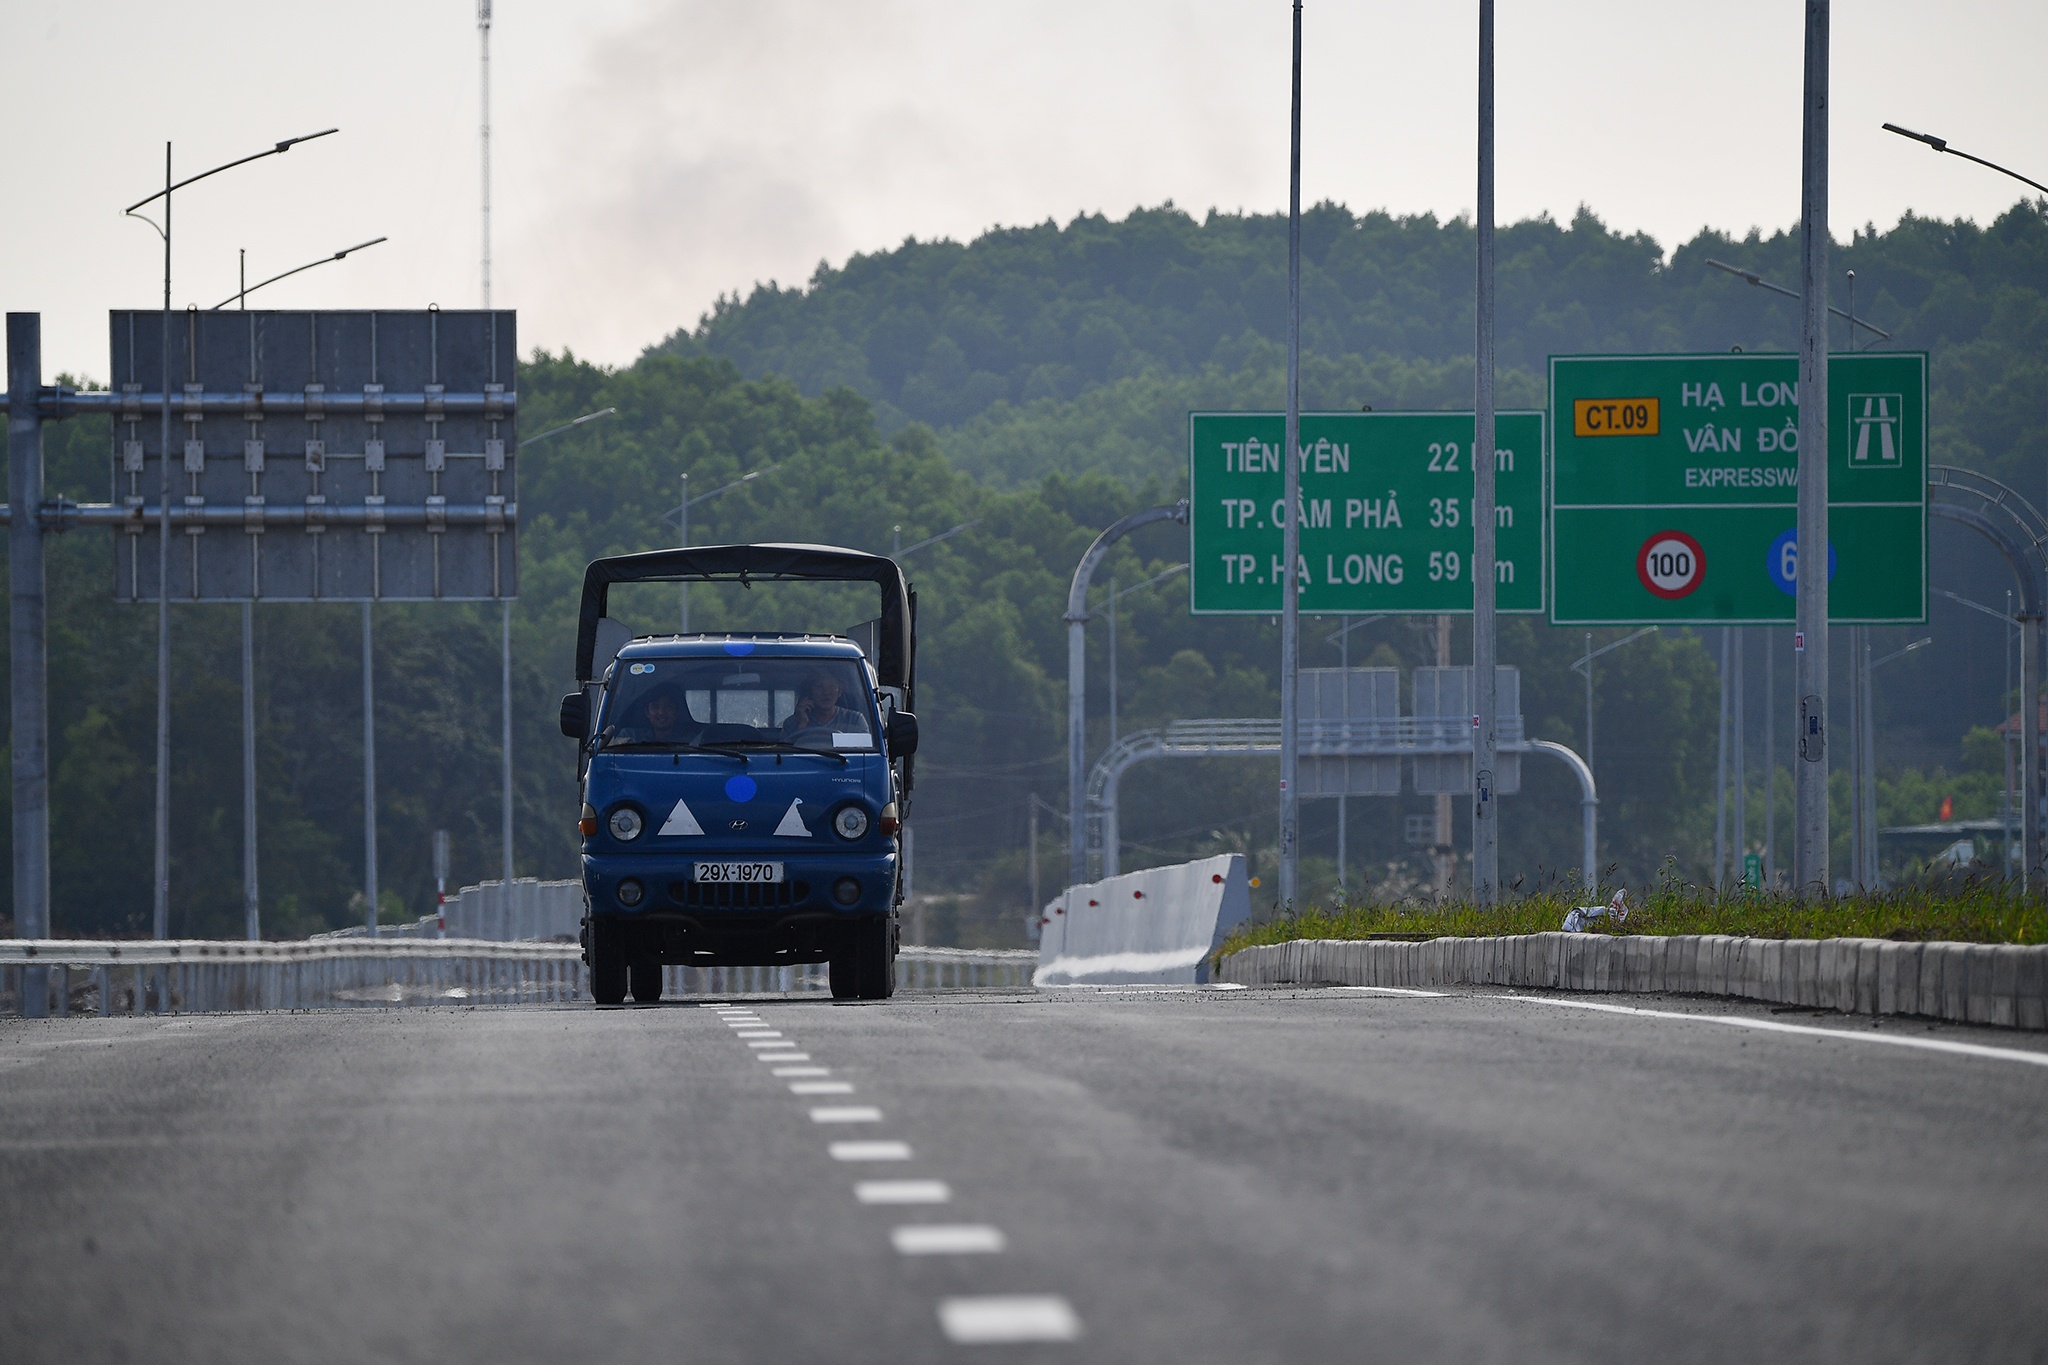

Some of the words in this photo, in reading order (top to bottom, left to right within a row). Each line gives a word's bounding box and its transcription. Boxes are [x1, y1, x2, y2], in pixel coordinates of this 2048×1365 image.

[1682, 382, 1725, 412] HẠ
[1741, 382, 1798, 407] LON
[1586, 404, 1648, 430] CT.09
[1683, 423, 1741, 453] VÂN
[1756, 416, 1798, 452] ĐỒ
[1221, 437, 1279, 472] TIÊN
[1299, 437, 1349, 473] YÊN
[1427, 442, 1459, 472] 22
[1472, 442, 1514, 472] m
[1685, 467, 1799, 488] EXPRESSW
[1345, 490, 1402, 528] PHẢ
[1429, 497, 1460, 528] 35
[1472, 498, 1513, 528] m
[1327, 554, 1403, 585] LONG
[1428, 551, 1461, 581] 59
[1472, 554, 1514, 583] m
[1650, 553, 1690, 577] 100
[1781, 541, 1798, 582] 6
[699, 863, 773, 881] 29X-1970
